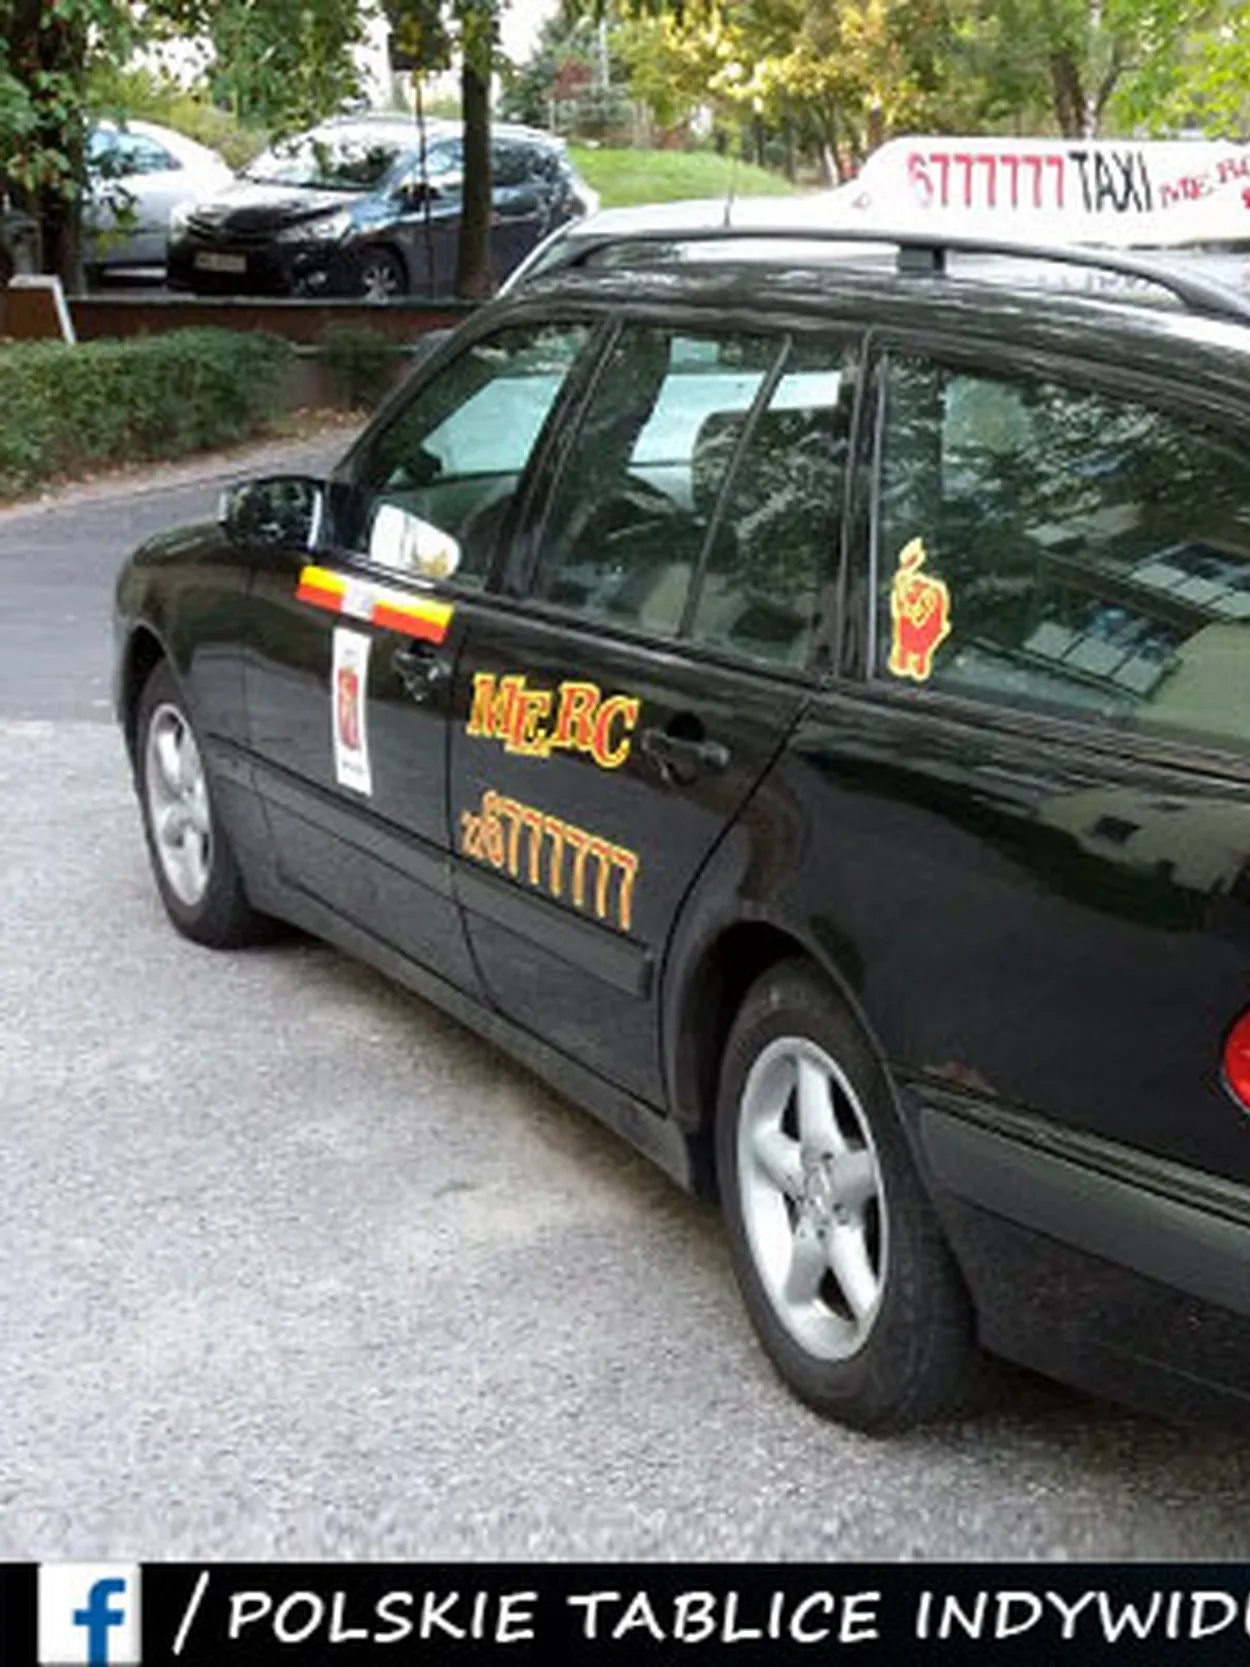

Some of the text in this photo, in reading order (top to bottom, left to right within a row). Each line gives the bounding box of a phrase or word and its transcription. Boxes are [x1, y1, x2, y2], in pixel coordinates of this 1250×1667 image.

[907, 151, 1065, 208] 6777777
[1067, 150, 1152, 213] TAXI
[466, 672, 640, 768] MERC
